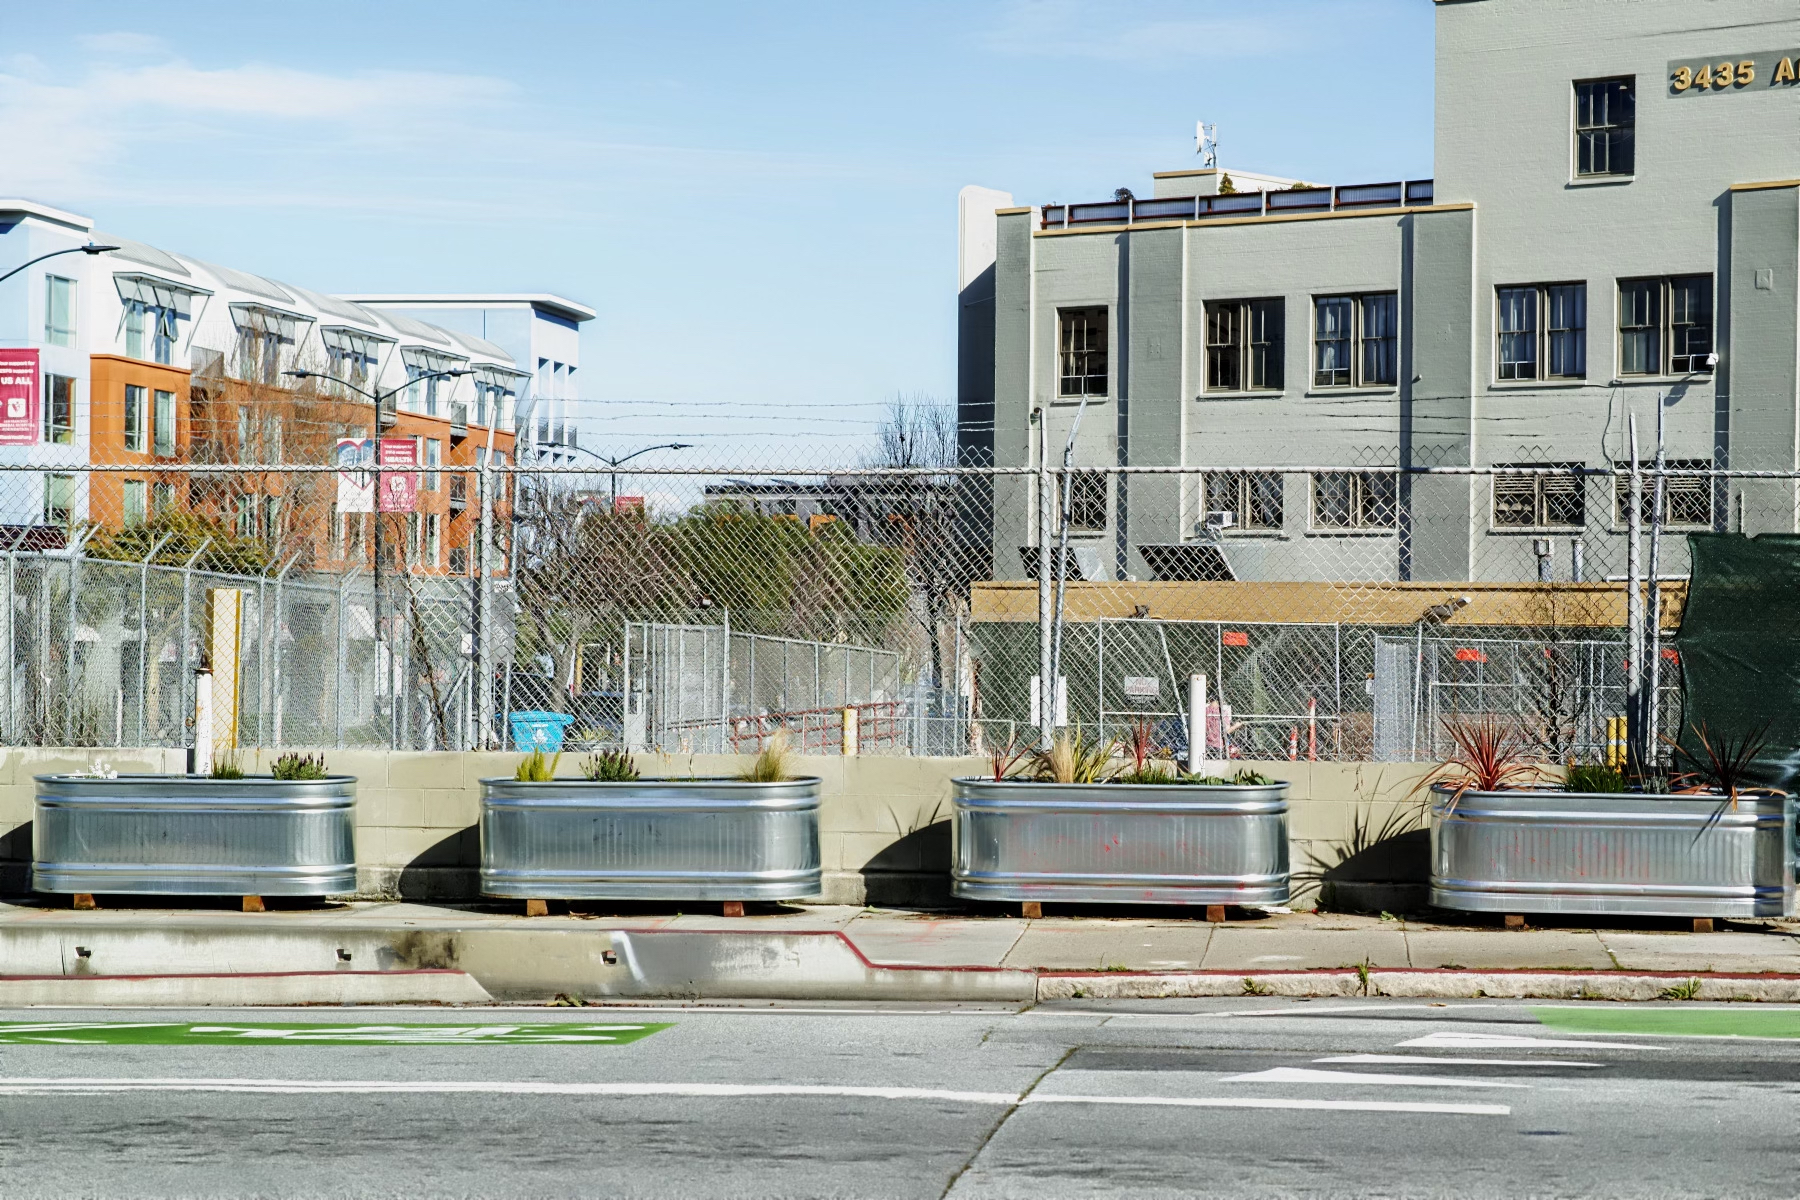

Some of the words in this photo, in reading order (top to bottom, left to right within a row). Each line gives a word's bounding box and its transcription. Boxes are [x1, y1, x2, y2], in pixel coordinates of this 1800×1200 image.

[1673, 60, 1755, 90] 3435
[1775, 56, 1800, 82] A
[1, 376, 13, 384] US
